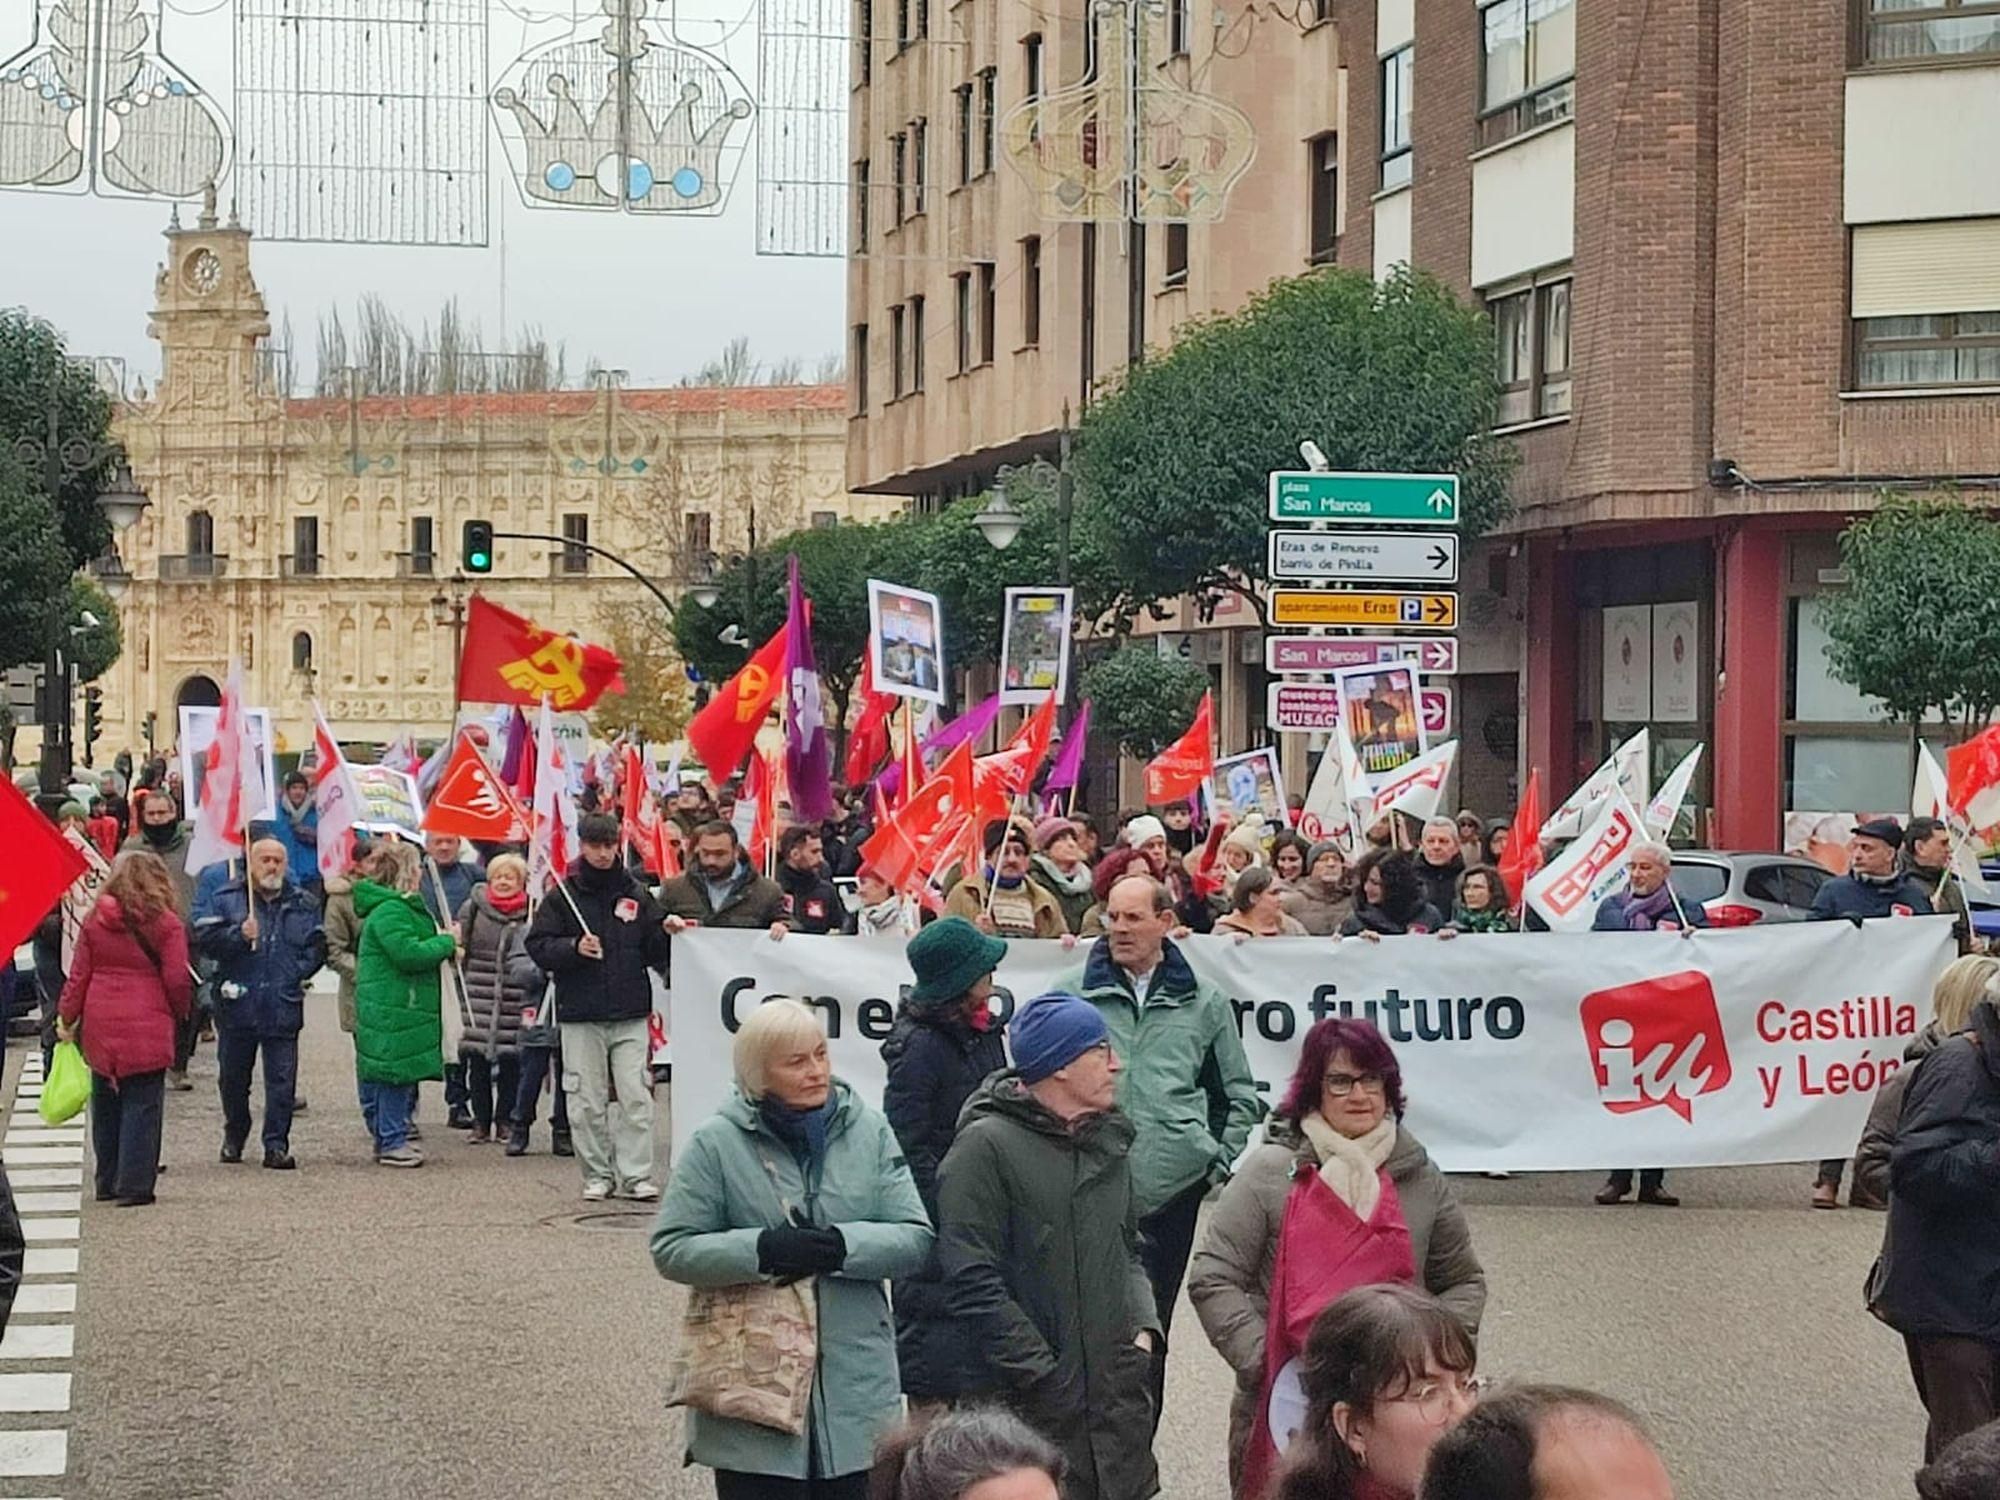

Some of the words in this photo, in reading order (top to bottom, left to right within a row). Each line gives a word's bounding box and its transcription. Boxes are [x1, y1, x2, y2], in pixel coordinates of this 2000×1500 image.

[1282, 482, 1310, 494] plaza
[1283, 496, 1311, 511] San
[1320, 497, 1372, 513] Marcos
[1280, 541, 1305, 553] Eras
[1311, 542, 1325, 553] de
[1331, 542, 1379, 554] Renueva
[1280, 558, 1312, 570] barrio
[1319, 559, 1333, 570] de
[1339, 559, 1373, 571] Pinilla
[1279, 602, 1359, 614] aparcamiento
[1363, 600, 1397, 614] Eras
[1279, 648, 1308, 663] San
[1317, 648, 1368, 664] Marcos
[1279, 713, 1335, 726] MUSAC
[1756, 995, 1916, 1043] Castilla
[1597, 1018, 1712, 1103] iu
[1758, 1064, 1782, 1108] y
